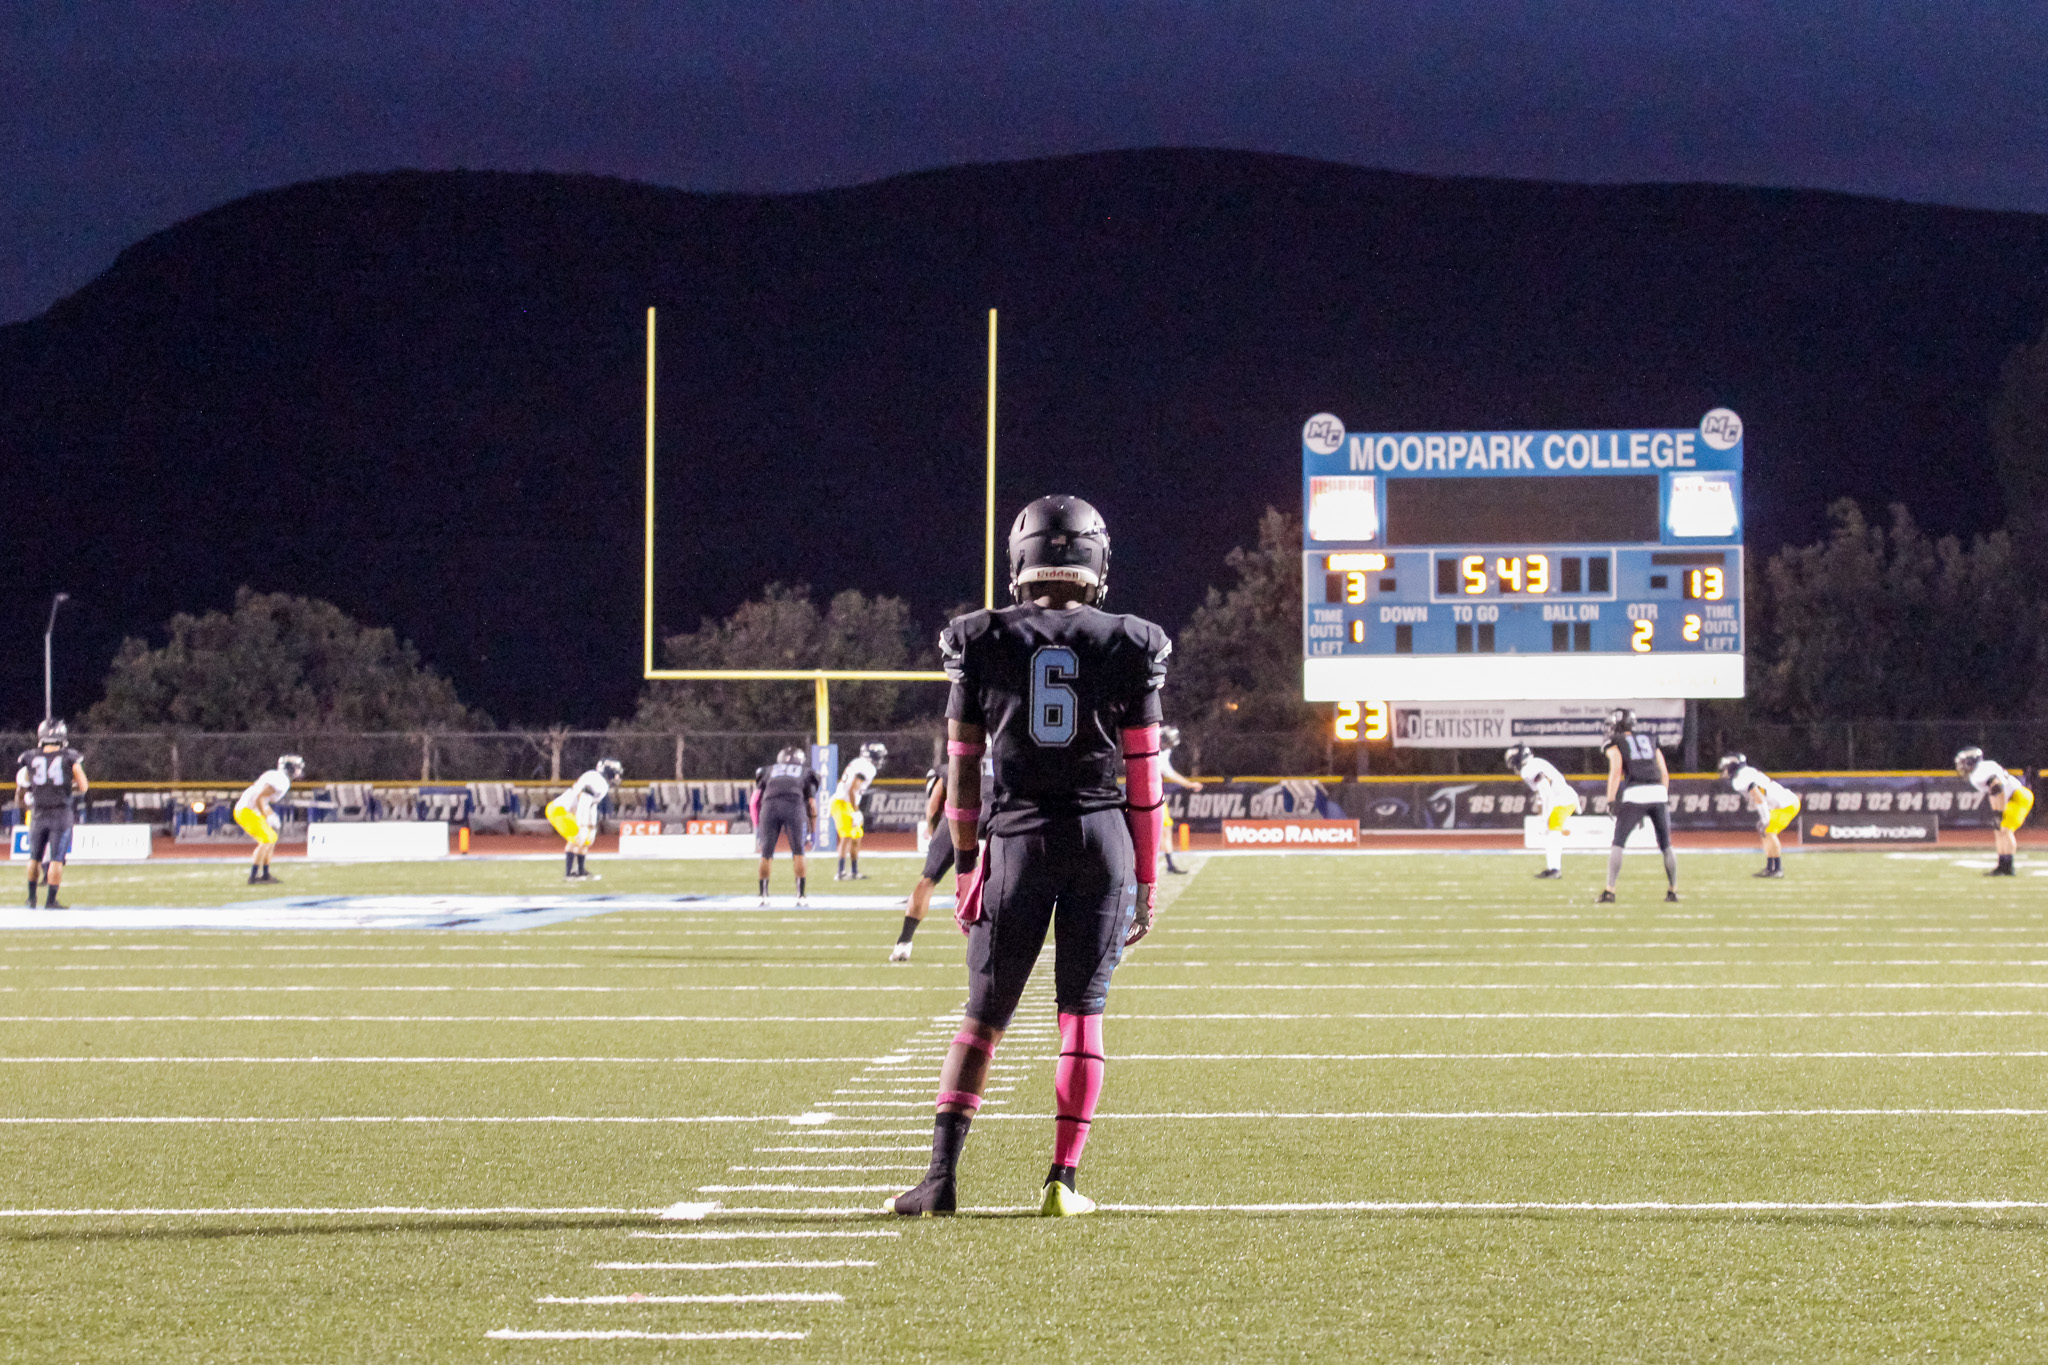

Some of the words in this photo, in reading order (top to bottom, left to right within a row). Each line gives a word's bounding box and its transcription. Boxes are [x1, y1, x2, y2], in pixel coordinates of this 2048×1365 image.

[1350, 435, 1535, 471] MOORPARK
[1543, 433, 1696, 469] COLLEGE
[1346, 571, 1366, 604] 3
[1691, 566, 1724, 600] 13
[1313, 609, 1343, 623] TIME
[1380, 606, 1428, 623] DOWN
[1453, 605, 1473, 622] TO
[1476, 605, 1499, 622] GO
[1543, 604, 1577, 621] BALL
[1579, 604, 1600, 620] ON
[1627, 603, 1658, 620] QTR
[1704, 605, 1735, 619] TIME
[1310, 624, 1344, 638] OUTS
[1353, 619, 1364, 643] 1
[1631, 619, 1654, 652] 2
[1682, 614, 1701, 641] 2
[1704, 620, 1738, 634] OUTS
[1313, 641, 1344, 654] LEFT
[1704, 637, 1735, 651] LEFT
[1029, 645, 1079, 747] 6
[1335, 700, 1388, 740] 23
[1625, 735, 1655, 760] 19
[31, 756, 64, 785] 34
[870, 793, 929, 812] RAIDE
[1188, 794, 1246, 818] BOWL
[1225, 827, 1284, 843] WOOD
